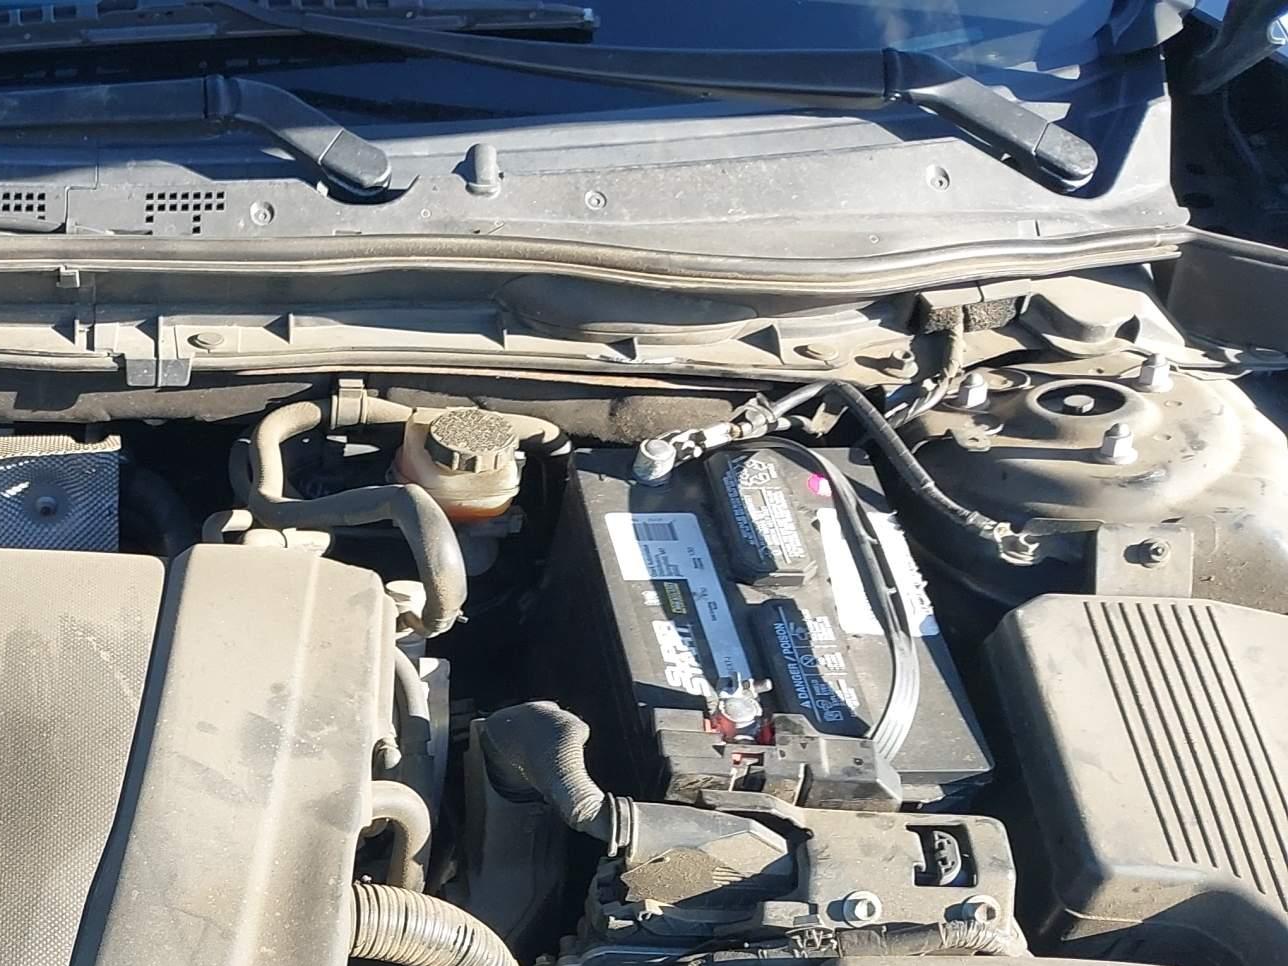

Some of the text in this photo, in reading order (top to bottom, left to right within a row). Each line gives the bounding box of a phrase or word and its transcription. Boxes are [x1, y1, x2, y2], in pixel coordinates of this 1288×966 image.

[651, 620, 688, 688] SUPER
[672, 622, 708, 698] START
[773, 622, 793, 655] POISON
[787, 663, 809, 699] DANGER
